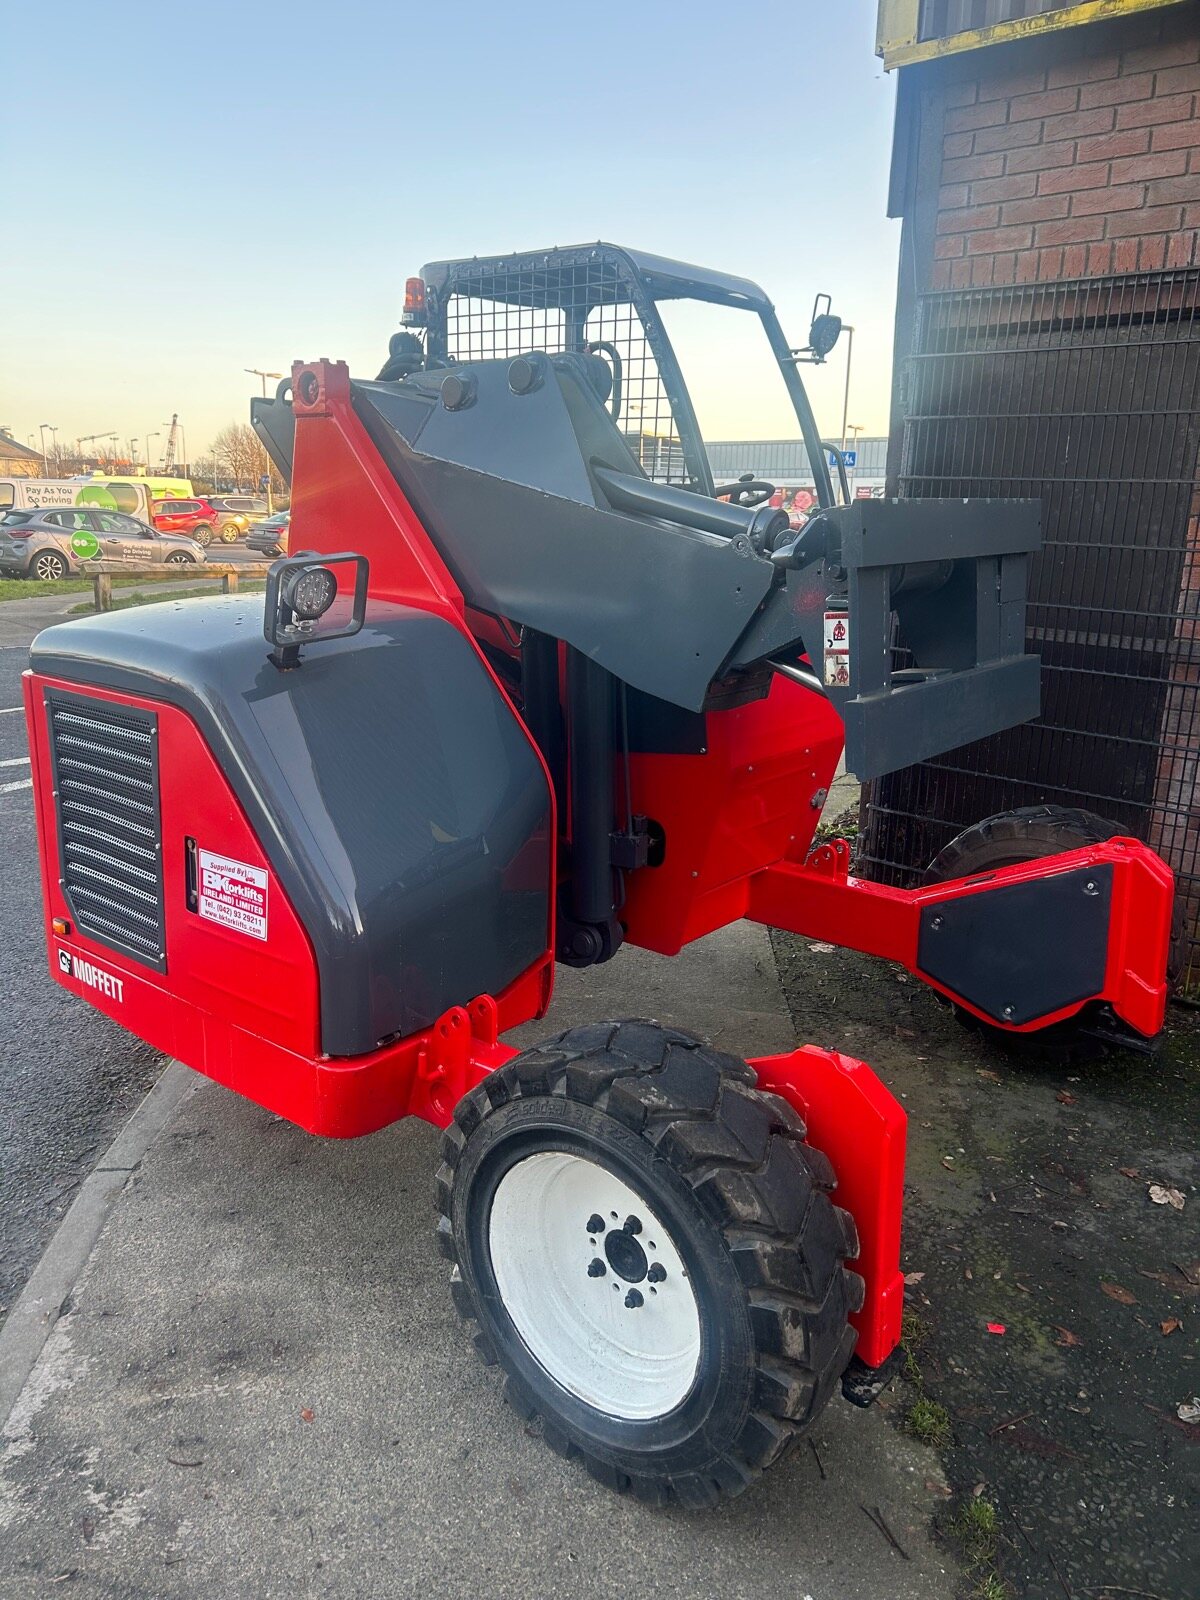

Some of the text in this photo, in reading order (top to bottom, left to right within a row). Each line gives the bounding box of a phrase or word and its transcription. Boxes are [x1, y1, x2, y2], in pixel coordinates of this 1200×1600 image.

[26, 487, 40, 495] Pay
[42, 496, 72, 504] Driving
[210, 862, 235, 874] Supplied
[203, 886, 235, 906] (IRELAND)
[235, 898, 263, 915] LIMITED
[205, 909, 261, 935] www.bkforklifts.com
[217, 903, 232, 917] (042)
[233, 908, 241, 919] 93
[243, 911, 262, 926] 29211
[72, 955, 123, 1003] MOFFETT
